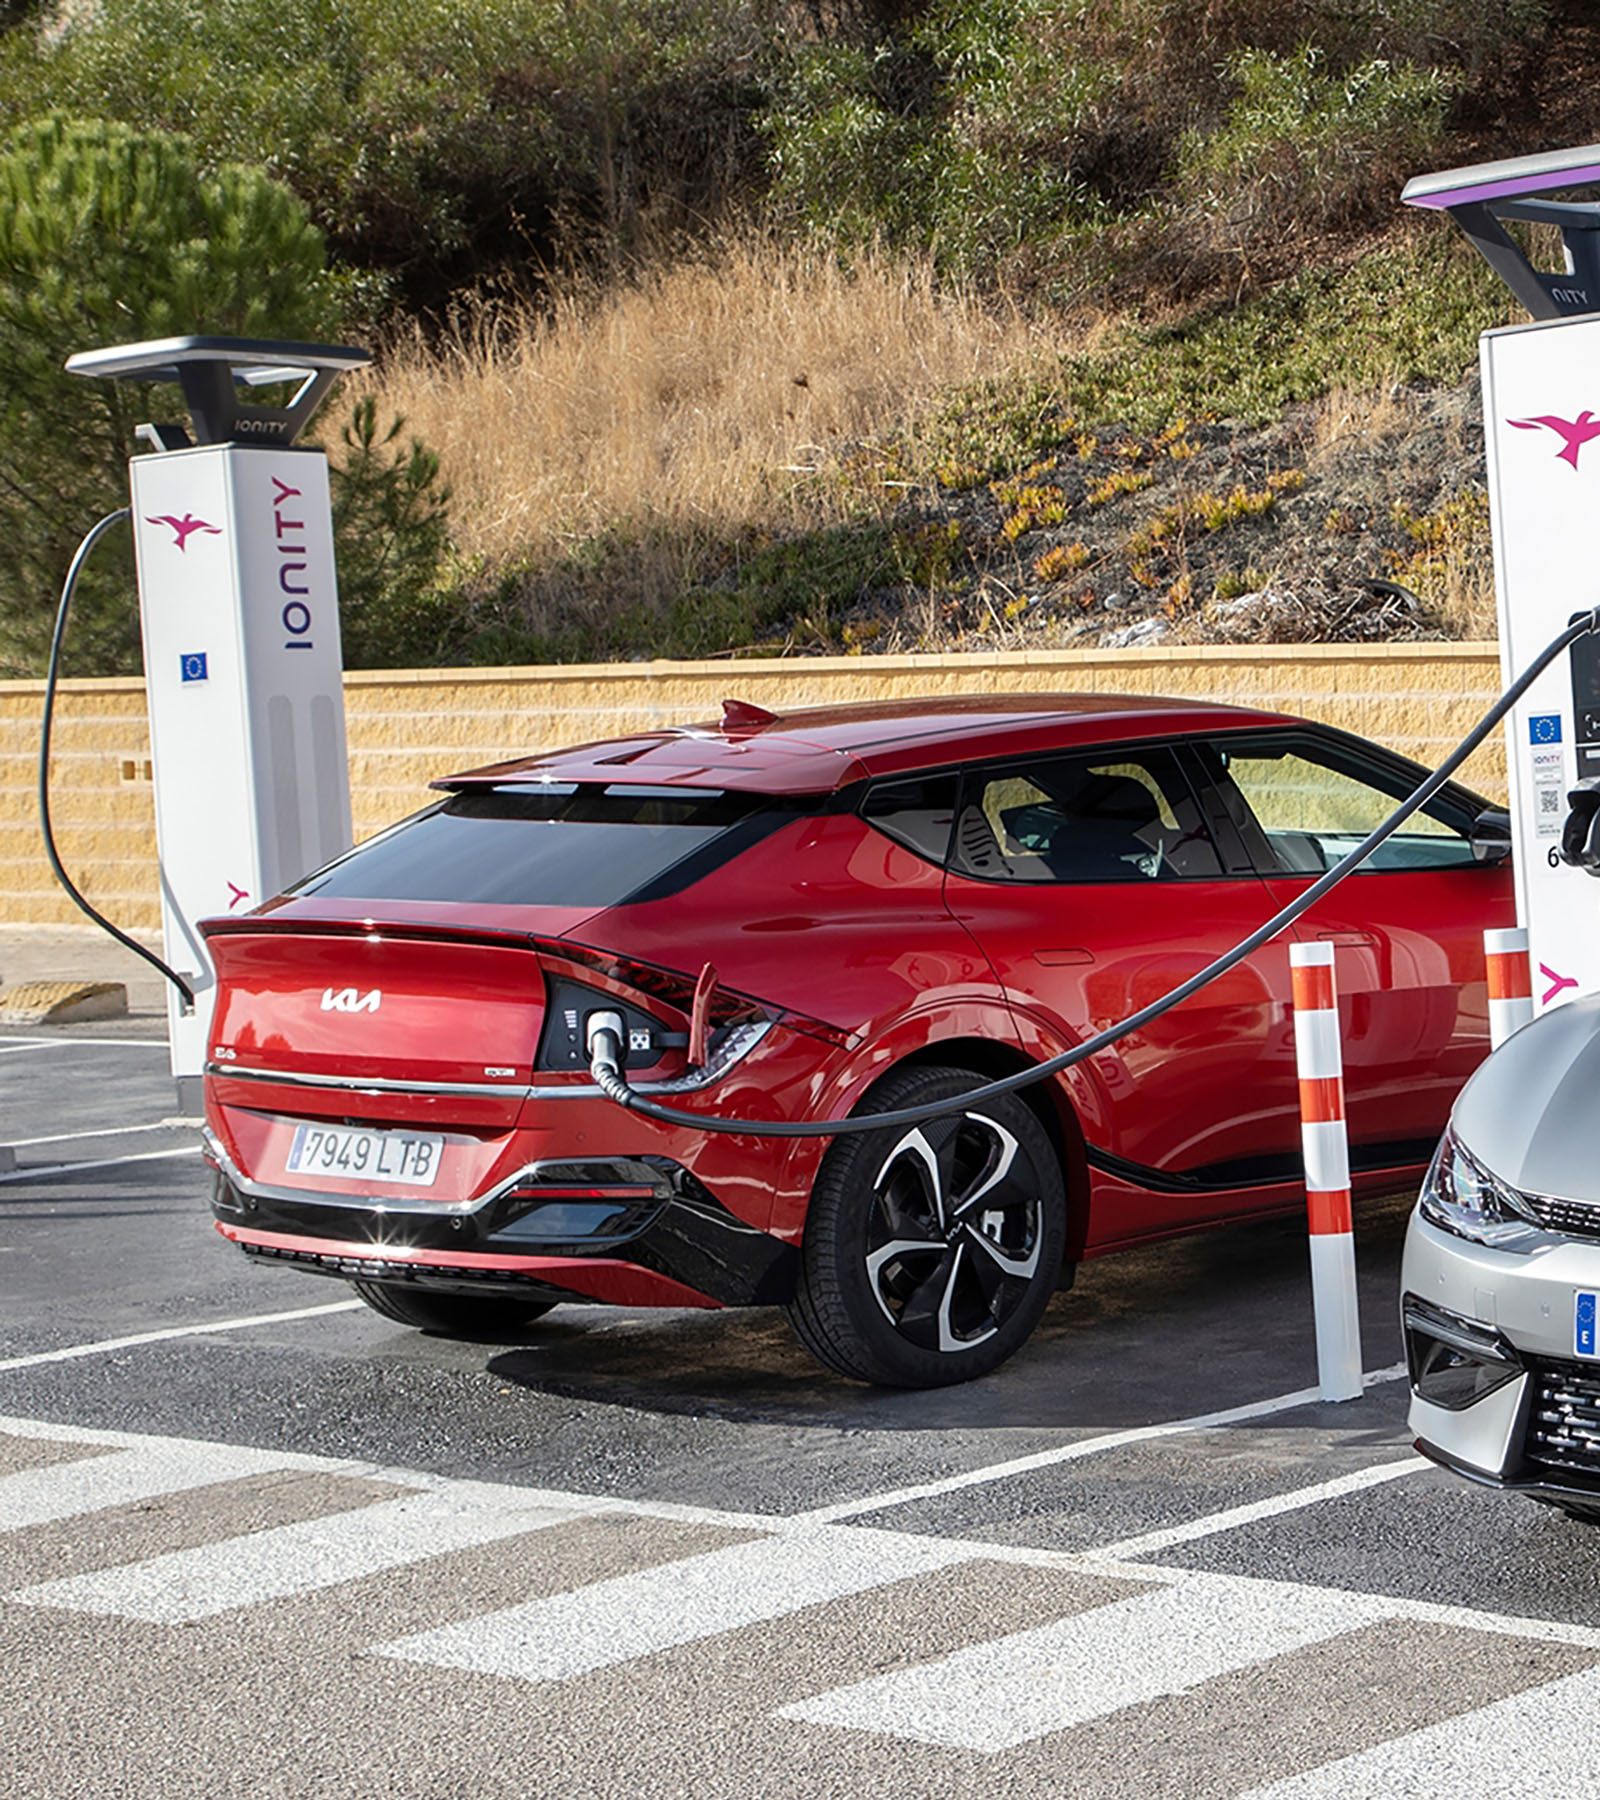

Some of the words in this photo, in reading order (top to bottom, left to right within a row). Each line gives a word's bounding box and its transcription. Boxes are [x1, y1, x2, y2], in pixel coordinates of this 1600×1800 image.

[234, 419, 288, 434] IONITY
[270, 474, 314, 650] IONITY
[1547, 845, 1560, 869] 6
[320, 987, 382, 1013] KIA
[306, 1131, 372, 1171] 7949
[376, 1137, 433, 1177] LTB
[1580, 1330, 1589, 1345] E
